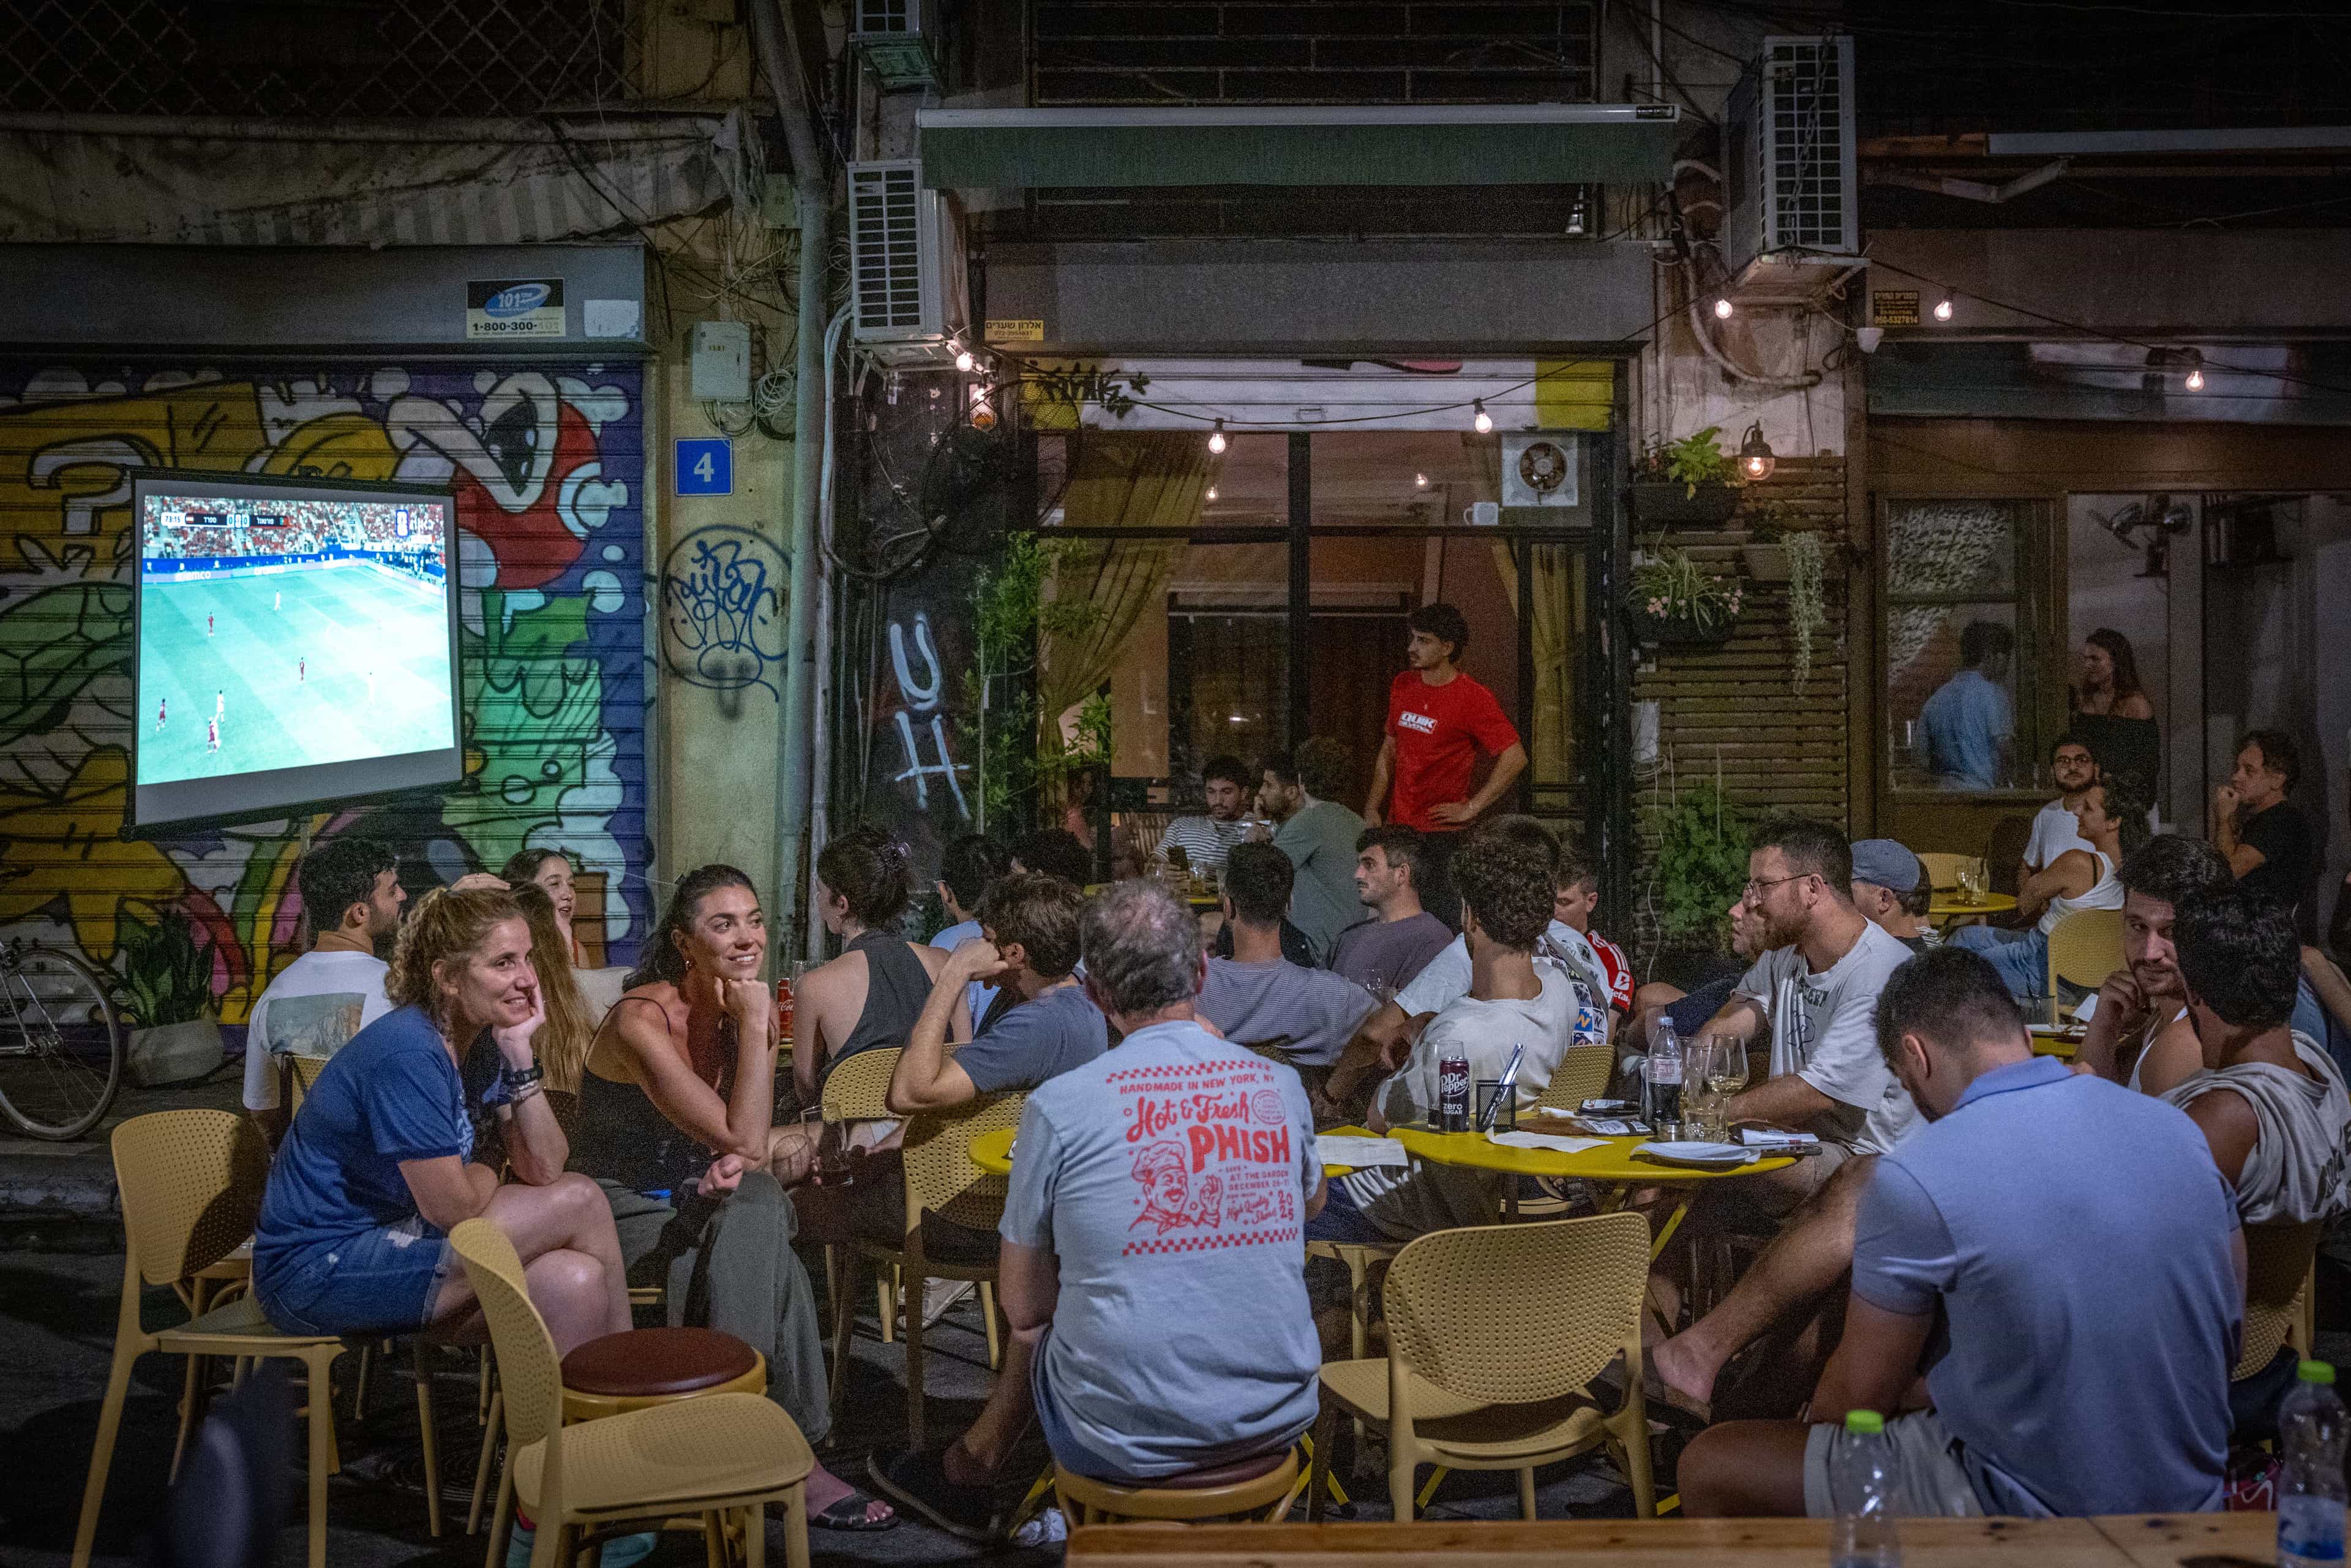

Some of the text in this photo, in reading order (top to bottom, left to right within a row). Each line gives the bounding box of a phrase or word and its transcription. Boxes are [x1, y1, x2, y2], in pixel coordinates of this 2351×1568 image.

[693, 452, 714, 482] 4
[1119, 1073, 1274, 1095] HANDMADE IN NEW YORK, NY
[1440, 1075, 1469, 1094] Pepper
[1448, 1073, 1461, 1083] Dr
[1126, 1096, 1177, 1142] Hot
[1180, 1098, 1193, 1119] &
[1192, 1091, 1250, 1124] Fresh
[1188, 1124, 1290, 1174] PHISH
[1229, 1180, 1269, 1191] DECEMBER
[1278, 1189, 1292, 1206] 20
[1280, 1204, 1294, 1221] 25
